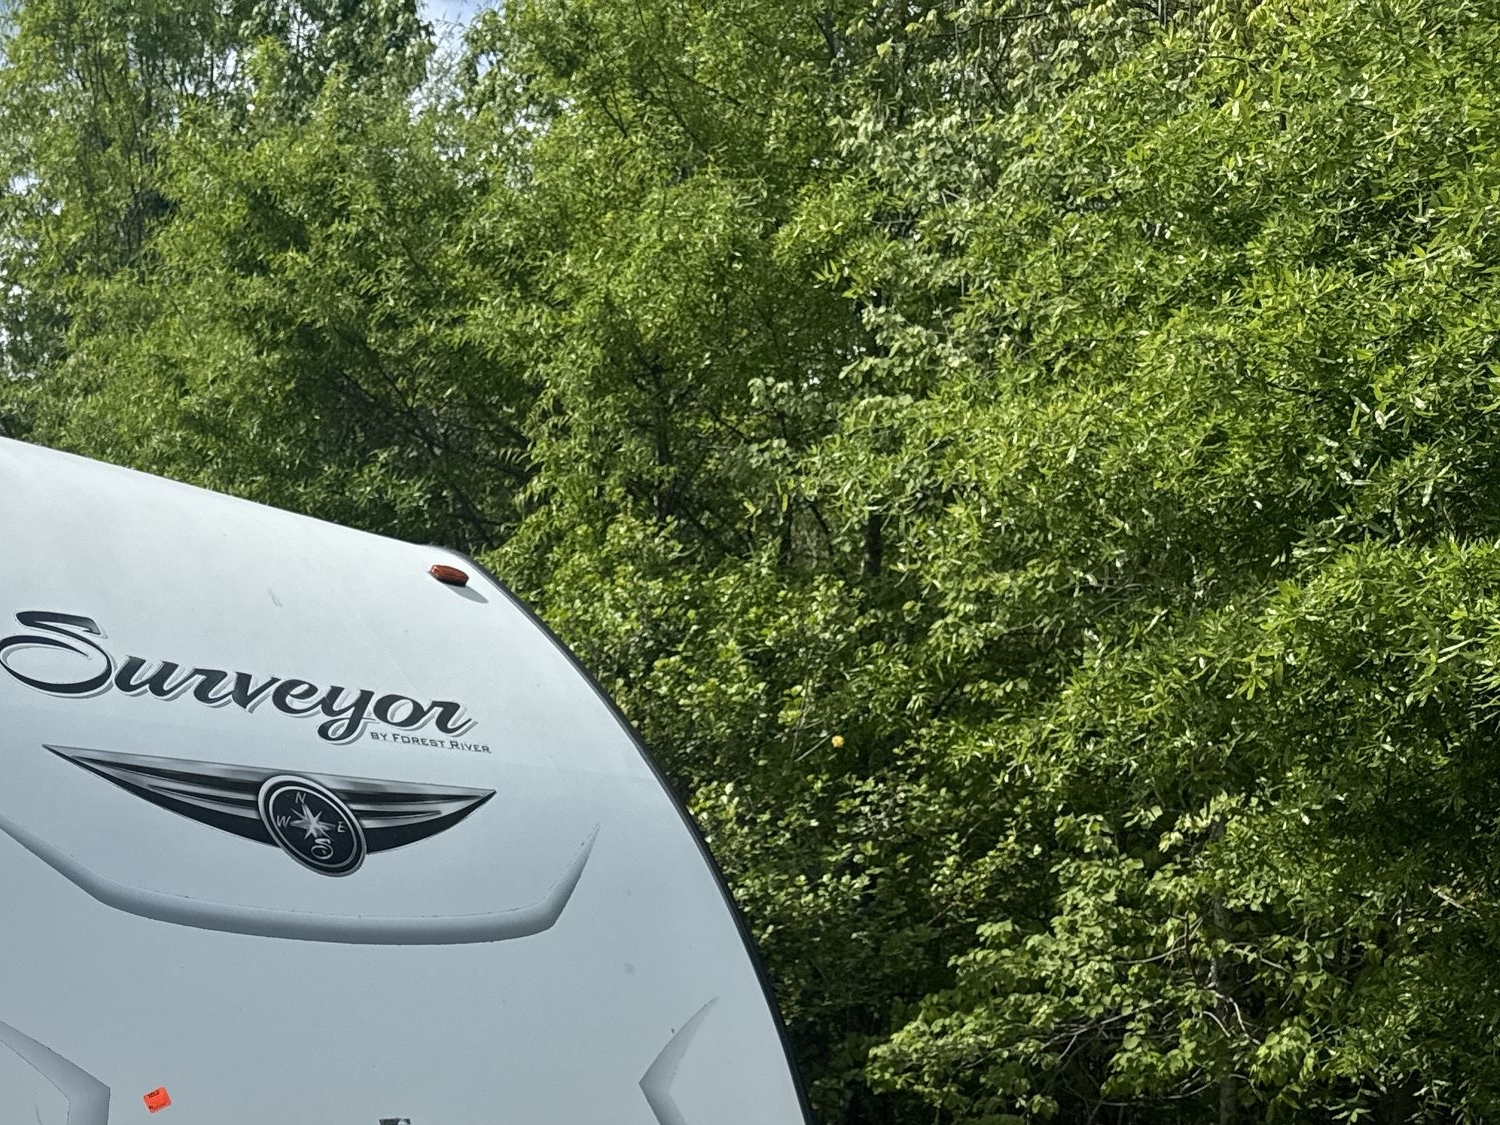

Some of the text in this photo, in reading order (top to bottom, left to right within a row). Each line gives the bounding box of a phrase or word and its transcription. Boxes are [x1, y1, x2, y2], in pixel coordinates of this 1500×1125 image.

[370, 732, 492, 754] BY FOREST RIVER
[295, 792, 306, 804] N
[276, 815, 346, 833] W E
